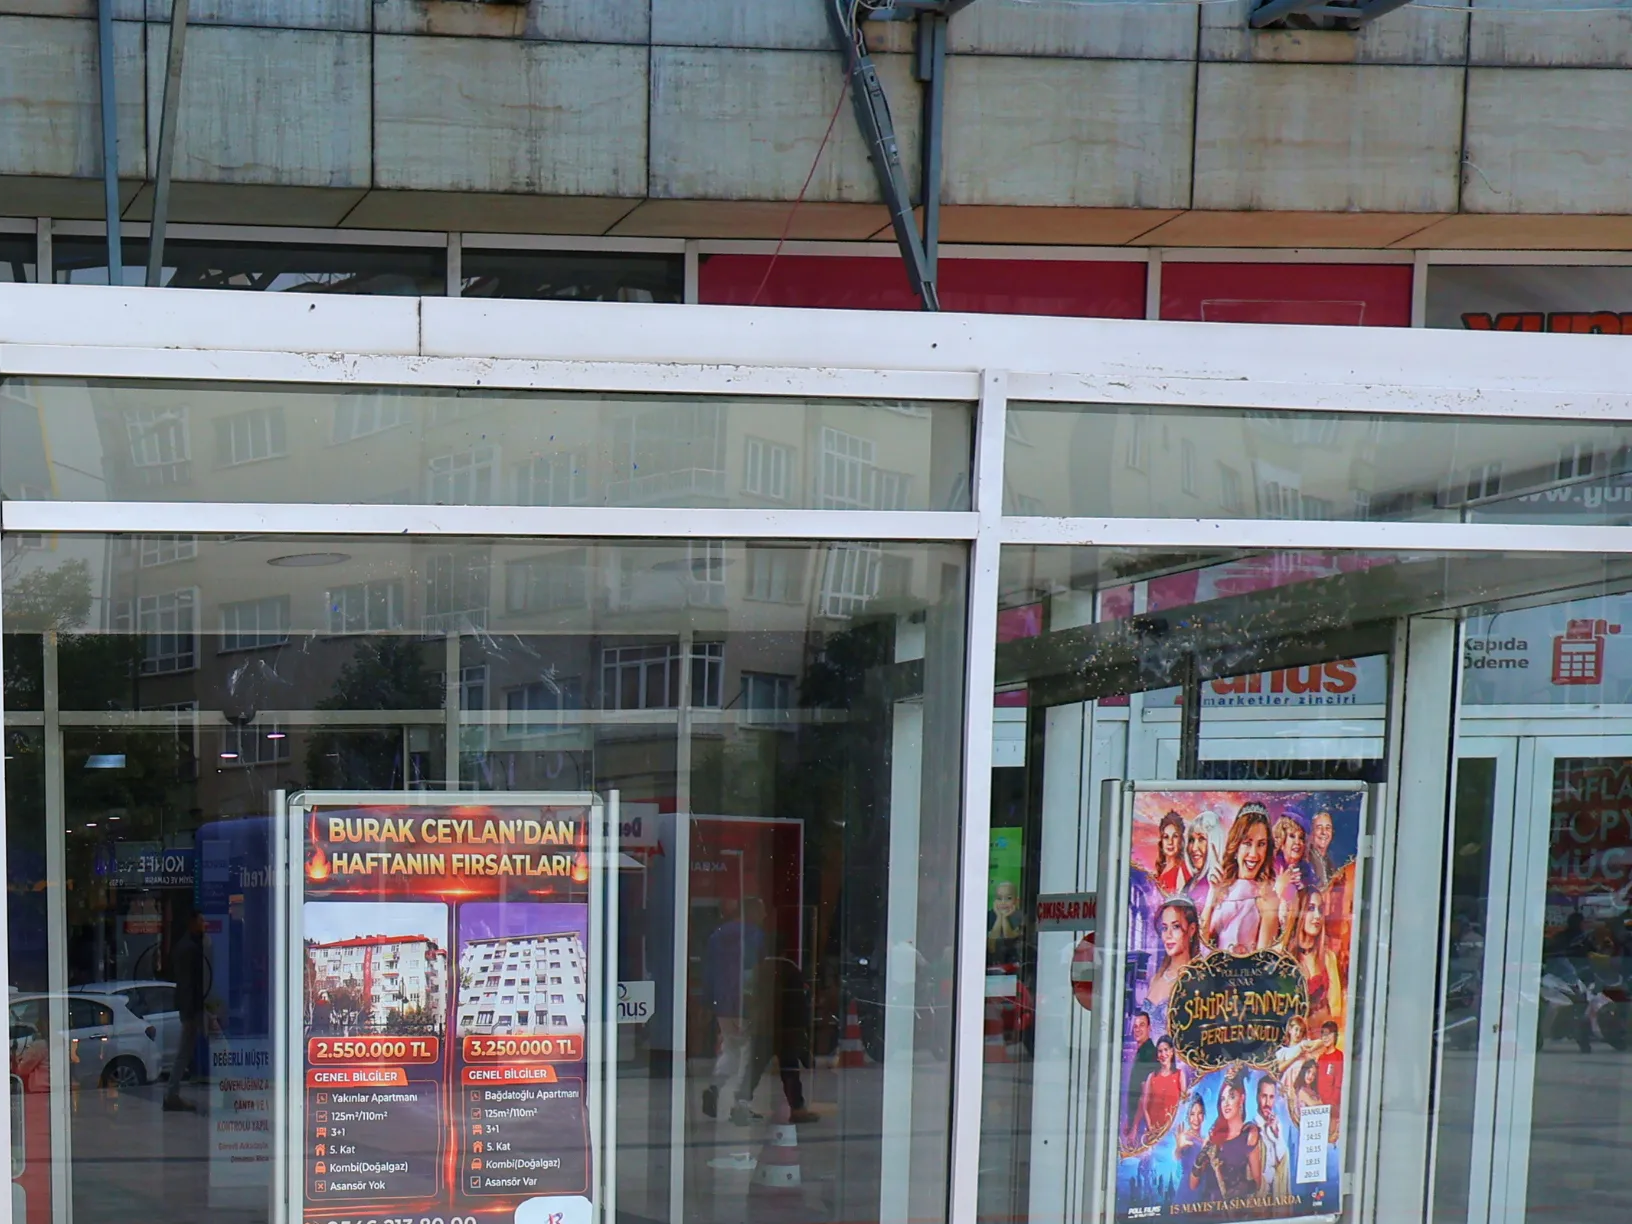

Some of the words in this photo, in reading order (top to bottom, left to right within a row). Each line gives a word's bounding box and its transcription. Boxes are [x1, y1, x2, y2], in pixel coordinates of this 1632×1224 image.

[1464, 637, 1529, 656] Kapıda
[1203, 694, 1291, 706] marketler
[1298, 693, 1357, 705] zinciri
[328, 817, 415, 843] BURAK
[421, 819, 574, 845] CEYLAN'DAN
[332, 852, 446, 875] HAFTANIN
[452, 854, 571, 877] FIRSATLARI
[1037, 901, 1081, 924] ÇIKIŞLAR
[1239, 990, 1300, 1022] ANNEM
[316, 1041, 406, 1059] 2.550.000
[410, 1041, 431, 1057] TL
[470, 1040, 553, 1057] 3.250.000
[556, 1039, 576, 1055] TL
[213, 1048, 243, 1067] DEĞERLİ
[314, 1072, 350, 1082] GENEL
[352, 1070, 398, 1082] BİLGİLER
[469, 1070, 502, 1080] GENEL
[504, 1068, 547, 1080] BİLGİLER
[332, 1093, 370, 1103] Yakınlar
[371, 1093, 418, 1106] Apartmanı
[484, 1090, 535, 1102] Bağdatoğlu
[536, 1089, 580, 1101] Apartmanı
[331, 1110, 388, 1122] 125m²/110m²
[485, 1107, 538, 1119] 125m²/110m²
[1300, 1106, 1330, 1117] SEANSLAR
[485, 1124, 500, 1134] 3+1
[1306, 1120, 1323, 1129] 12:15
[331, 1127, 346, 1137] 3+1
[329, 1146, 338, 1154] 5.
[340, 1145, 356, 1154] Kat
[486, 1142, 495, 1151] 5.
[496, 1142, 511, 1151] Kat
[330, 1161, 409, 1174] Kombi(Doğalgaz)
[485, 1158, 561, 1170] Kombi(Doğalgaz)
[330, 1180, 367, 1191] Asansör
[368, 1180, 386, 1190] Yok
[484, 1177, 521, 1188] Asansör
[522, 1176, 538, 1186] Var
[1169, 1203, 1181, 1215] 15
